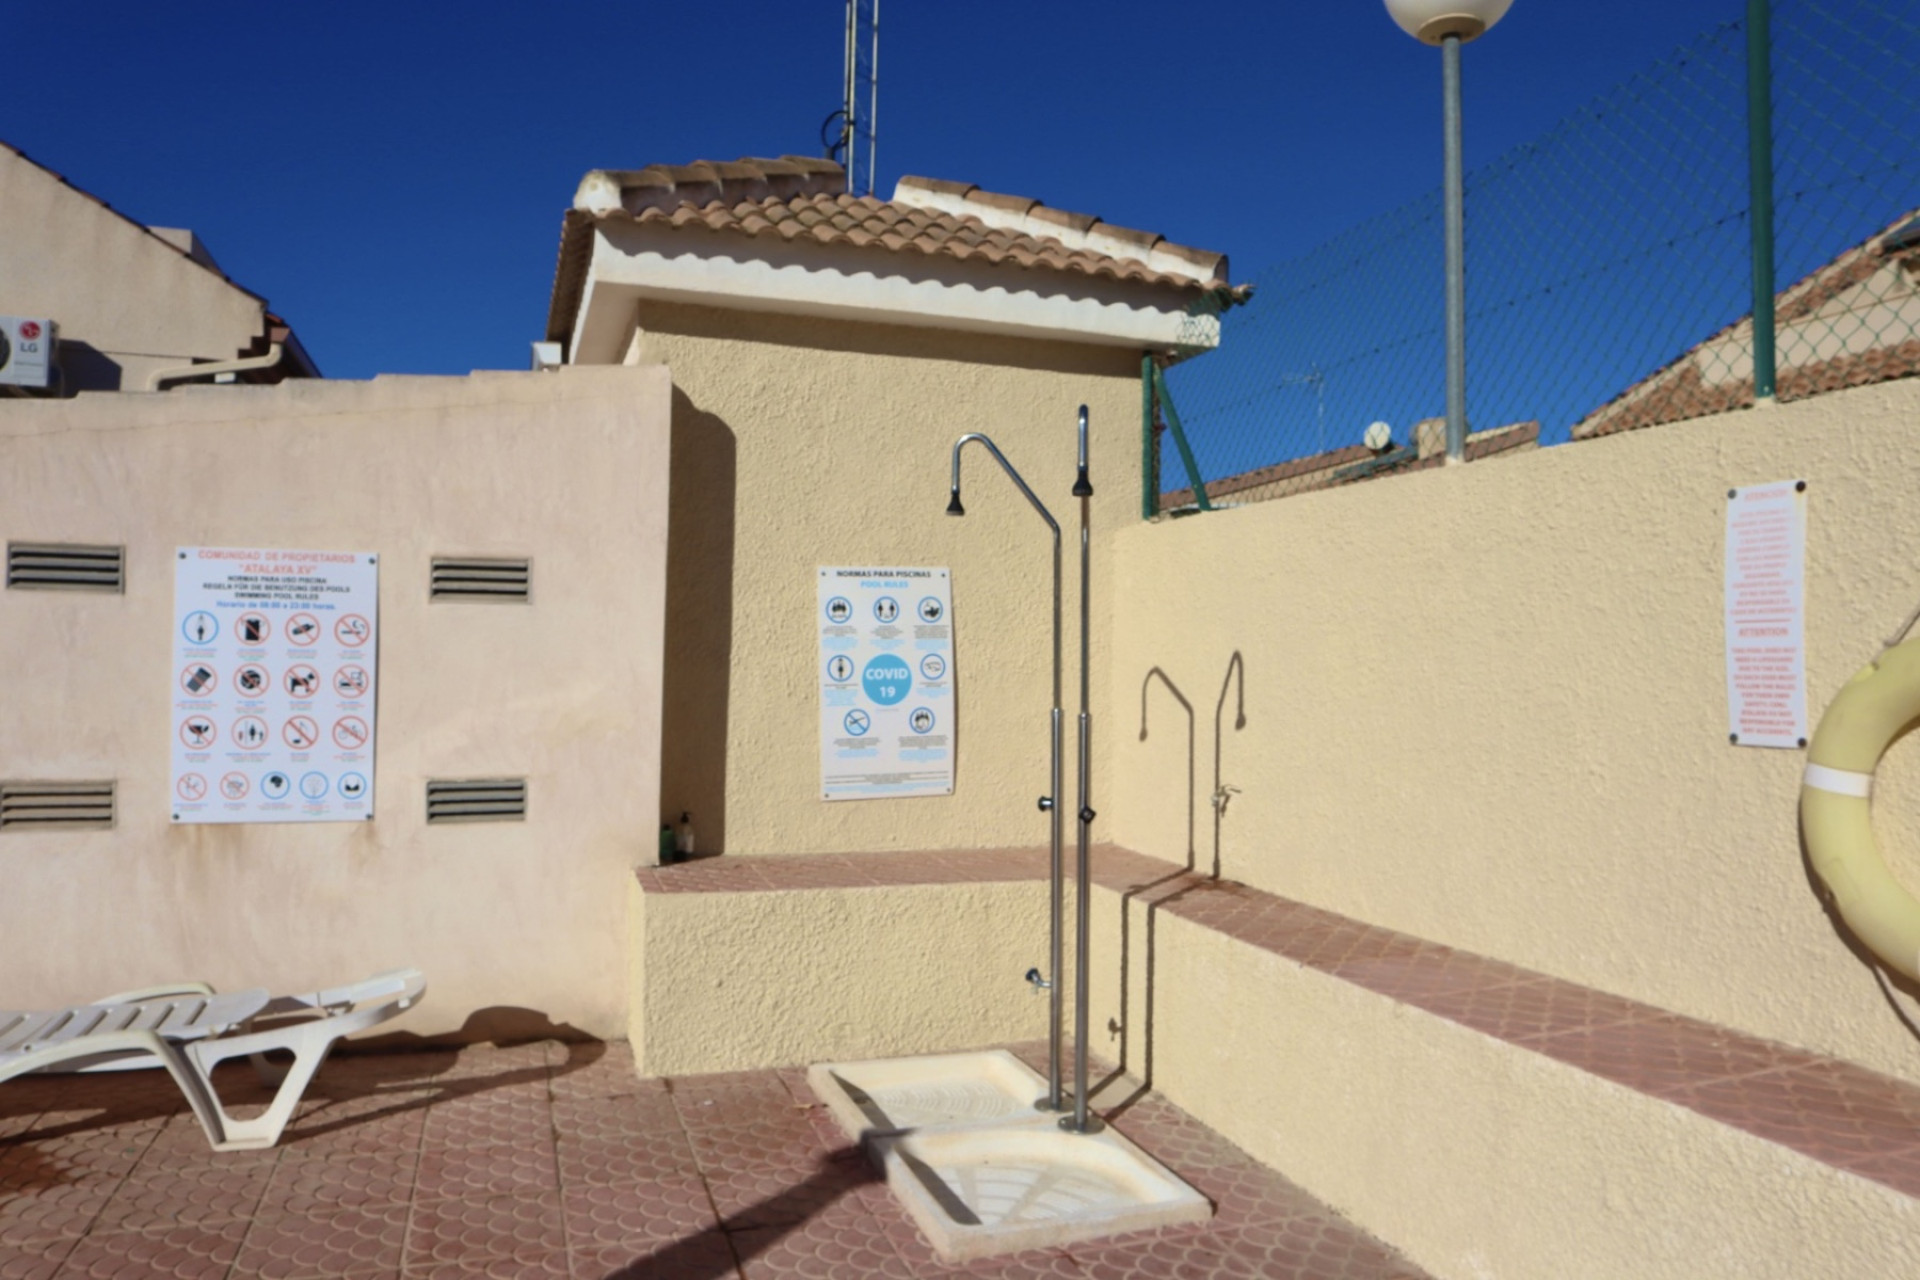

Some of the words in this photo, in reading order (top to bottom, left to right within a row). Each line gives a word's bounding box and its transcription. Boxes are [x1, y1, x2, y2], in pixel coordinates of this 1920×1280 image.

[20, 342, 38, 353] LG
[198, 549, 260, 560] COMUNIDAD
[265, 551, 278, 561] DE
[281, 552, 356, 564] PROPIETARIOS
[896, 570, 931, 578] PISCINAS
[861, 580, 882, 589] POOL
[883, 580, 909, 589] RULES
[216, 600, 245, 609] Horario
[1738, 627, 1788, 637] ATTENTION
[865, 667, 908, 681] COVID
[879, 686, 896, 698] 19
